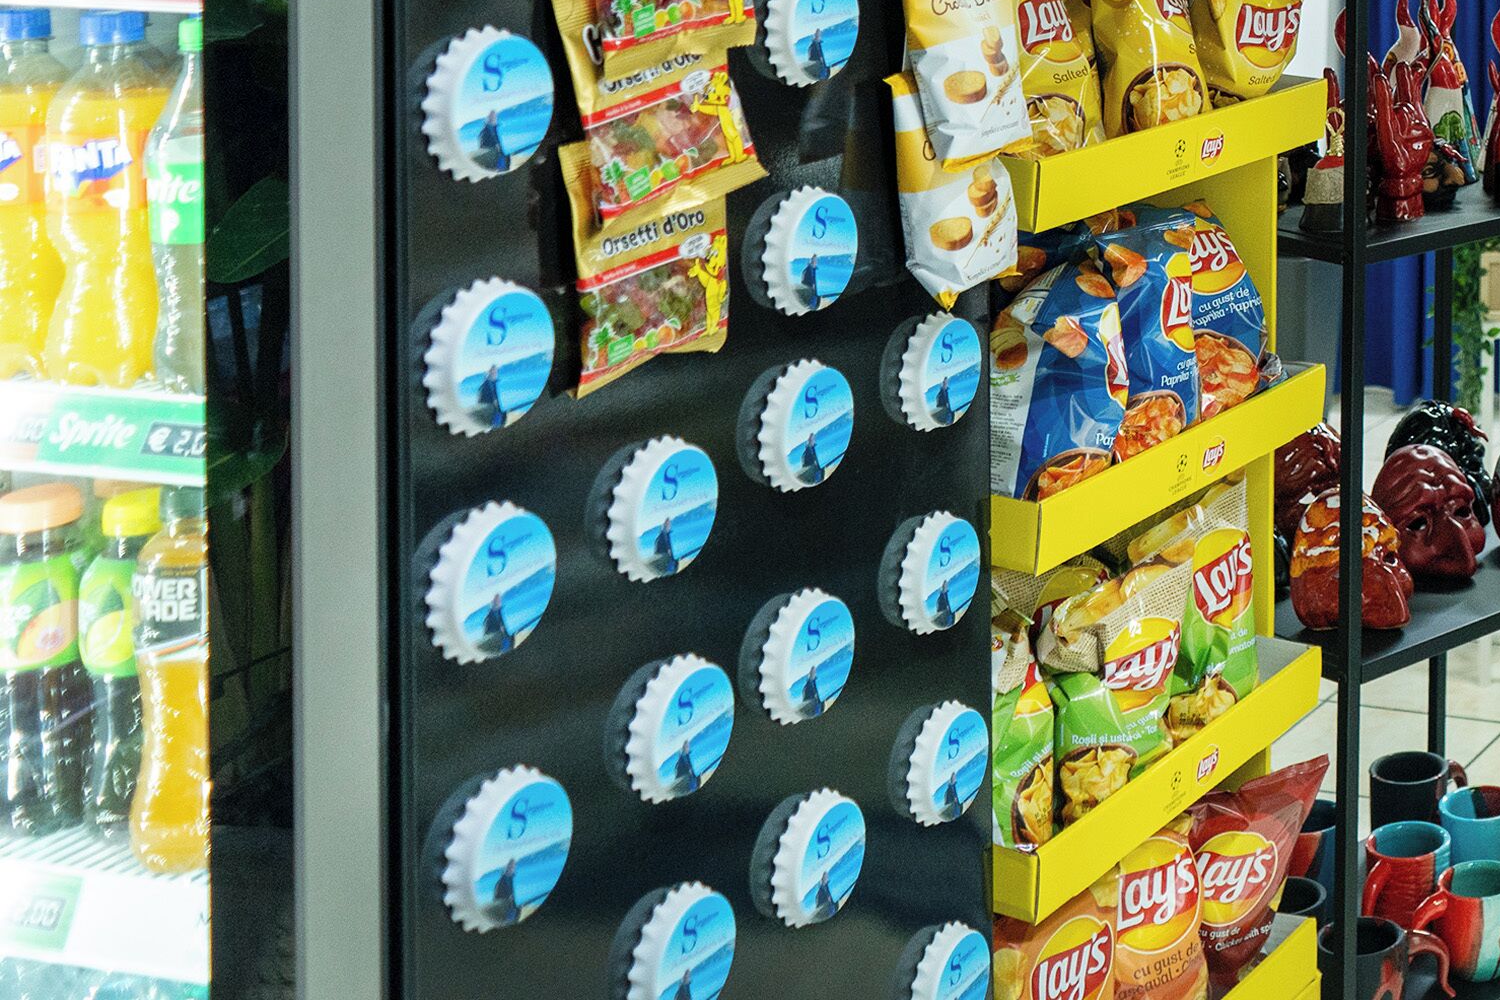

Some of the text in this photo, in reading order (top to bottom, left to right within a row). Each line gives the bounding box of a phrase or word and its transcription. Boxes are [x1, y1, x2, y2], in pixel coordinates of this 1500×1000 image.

[1240, 2, 1300, 51] Lay's
[1053, 65, 1089, 85] Salted
[602, 210, 705, 256] Orsetti d'Oro
[1198, 287, 1250, 313] cu gust de
[50, 411, 137, 453] Sprite
[131, 572, 198, 601] OWER
[145, 598, 199, 622] ADE
[1117, 853, 1198, 931] Lay's
[1198, 847, 1274, 904] Lay's
[1133, 965, 1151, 980] cu
[1153, 951, 1184, 977] gust
